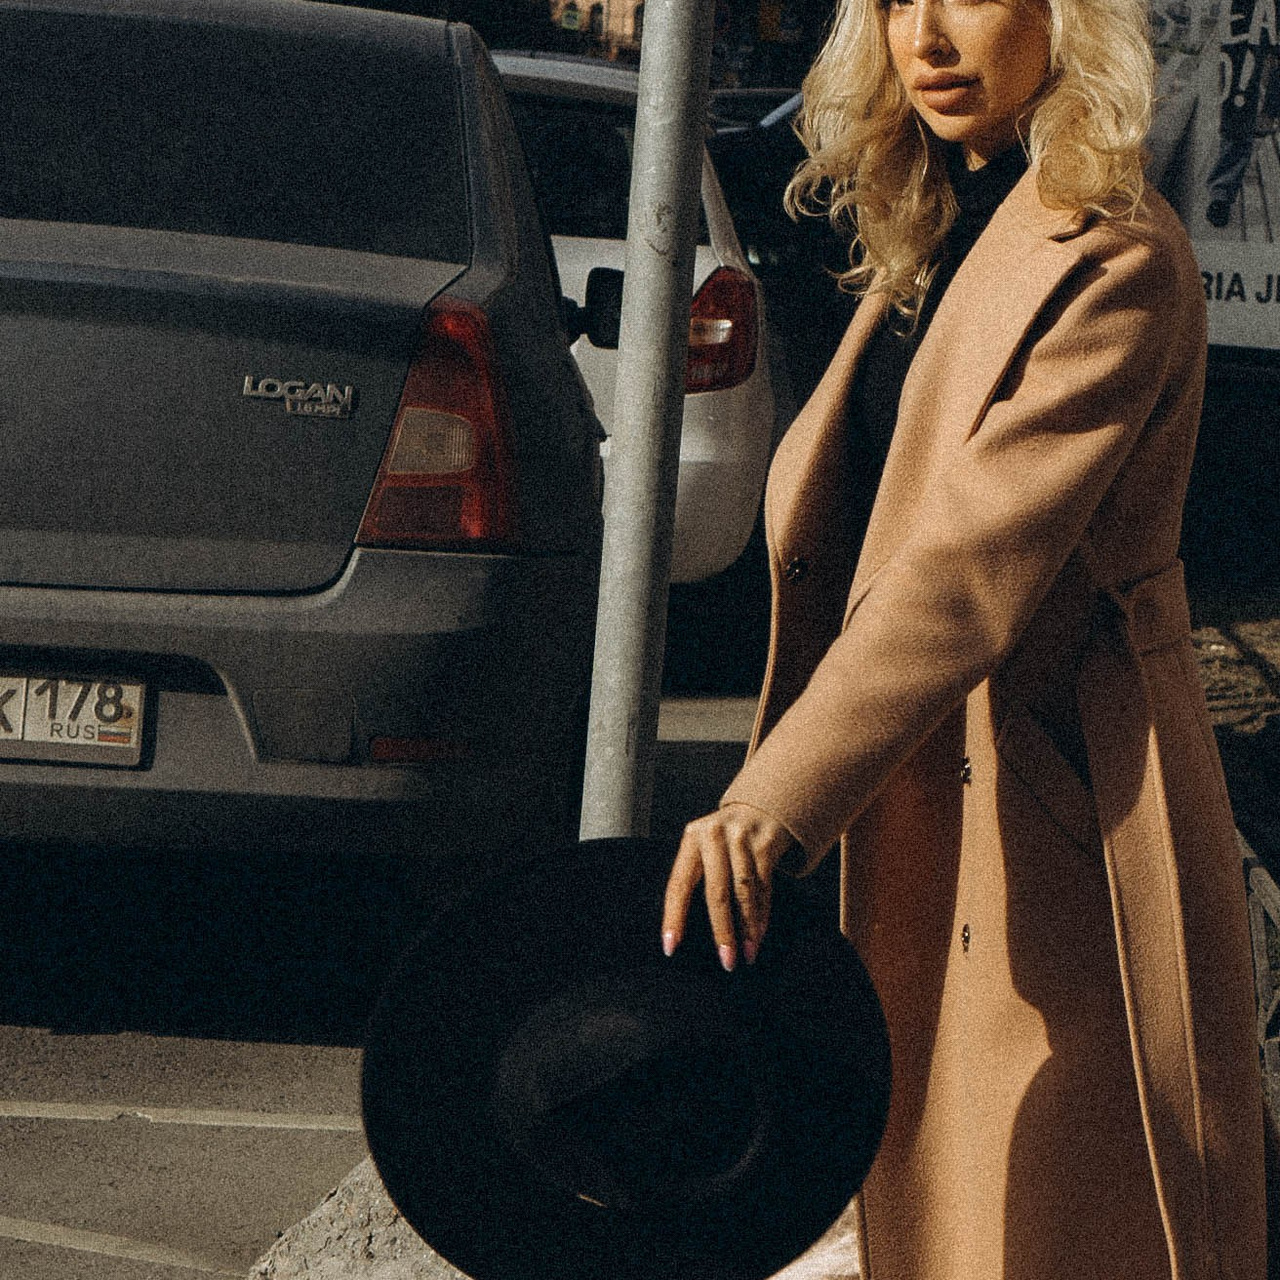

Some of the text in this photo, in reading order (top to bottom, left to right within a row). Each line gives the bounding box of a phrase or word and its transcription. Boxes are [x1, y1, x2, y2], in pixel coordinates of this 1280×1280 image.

[242, 375, 353, 410] LOGAN
[35, 679, 123, 723] 178
[50, 722, 96, 740] RUS
